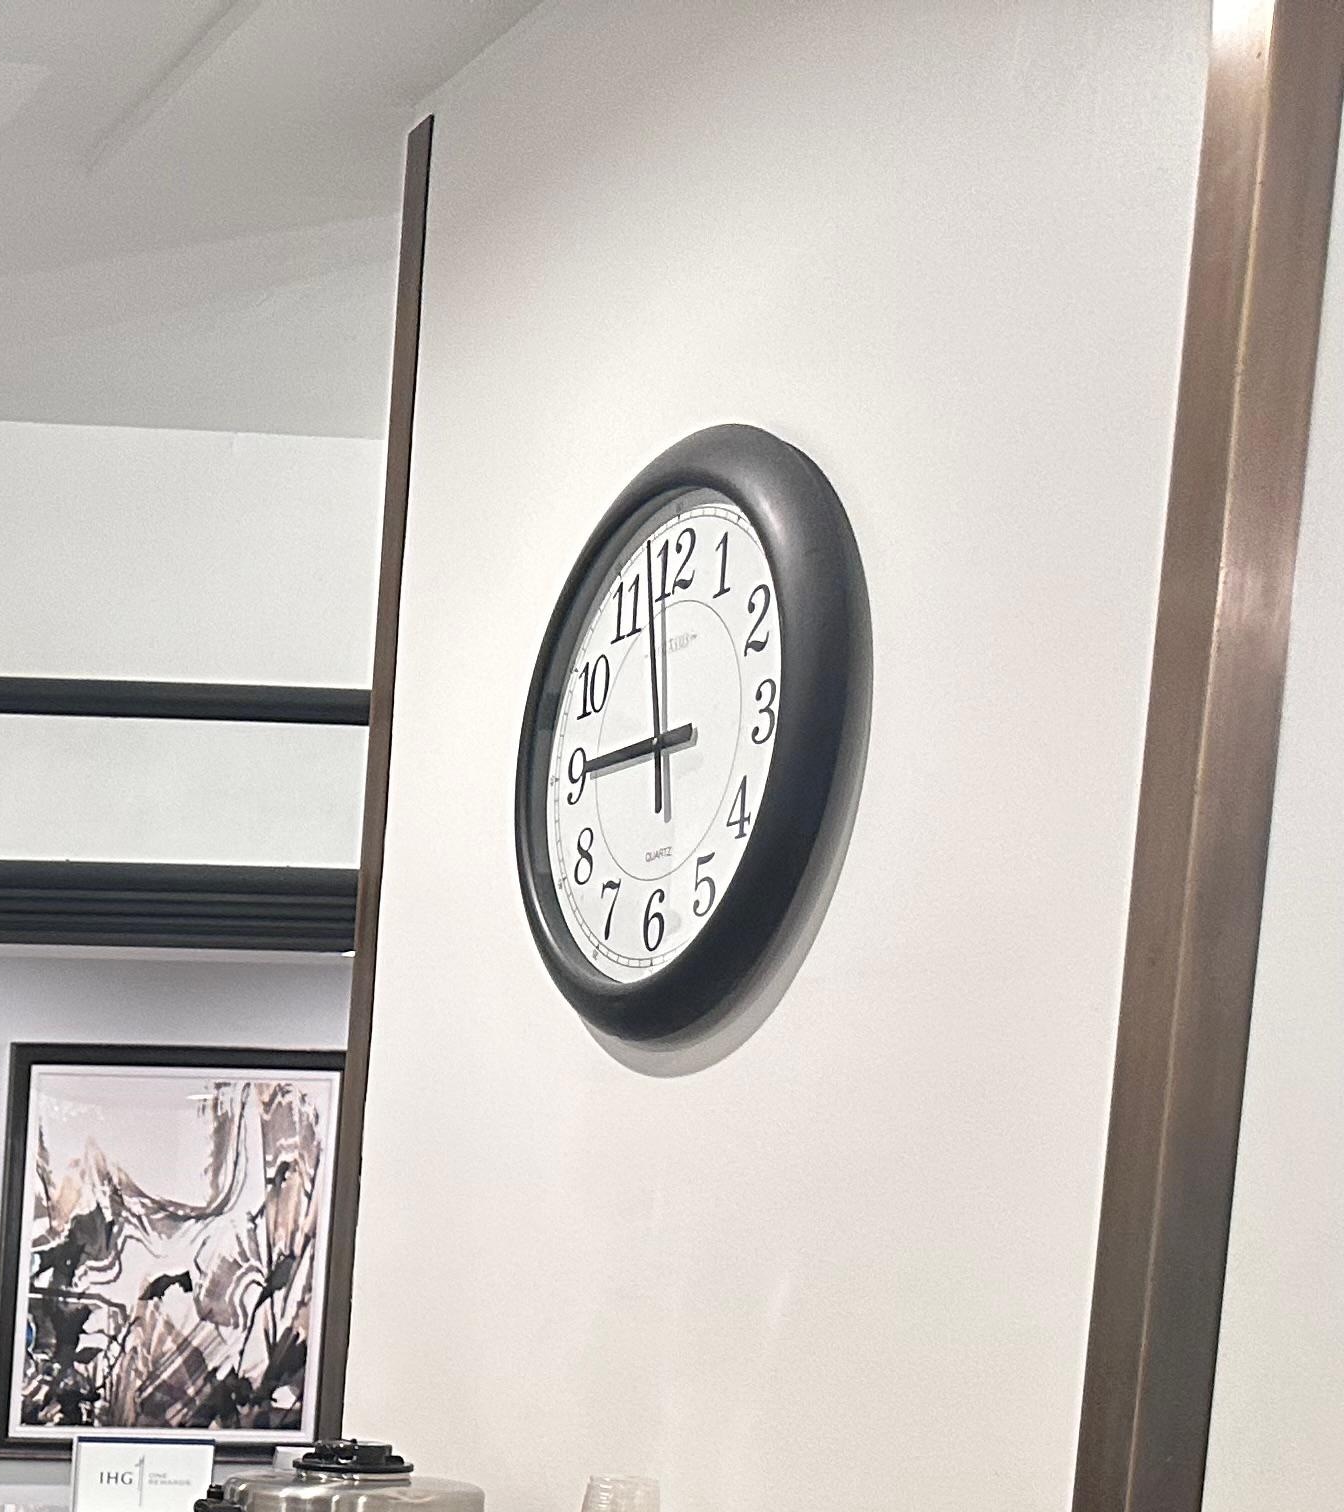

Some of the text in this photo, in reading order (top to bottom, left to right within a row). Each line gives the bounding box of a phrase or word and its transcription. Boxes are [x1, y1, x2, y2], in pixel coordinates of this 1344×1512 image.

[654, 528, 697, 602] 12
[713, 532, 730, 599] 1
[611, 574, 643, 645] 11
[743, 584, 772, 657] 2
[577, 655, 610, 721] 10
[752, 679, 777, 745] 3
[567, 747, 588, 805] 9
[727, 776, 751, 840] 4
[575, 827, 594, 885] 8
[693, 853, 716, 917] 5
[601, 880, 621, 940] 7
[643, 889, 665, 952] 6
[99, 1471, 134, 1485] IHG
